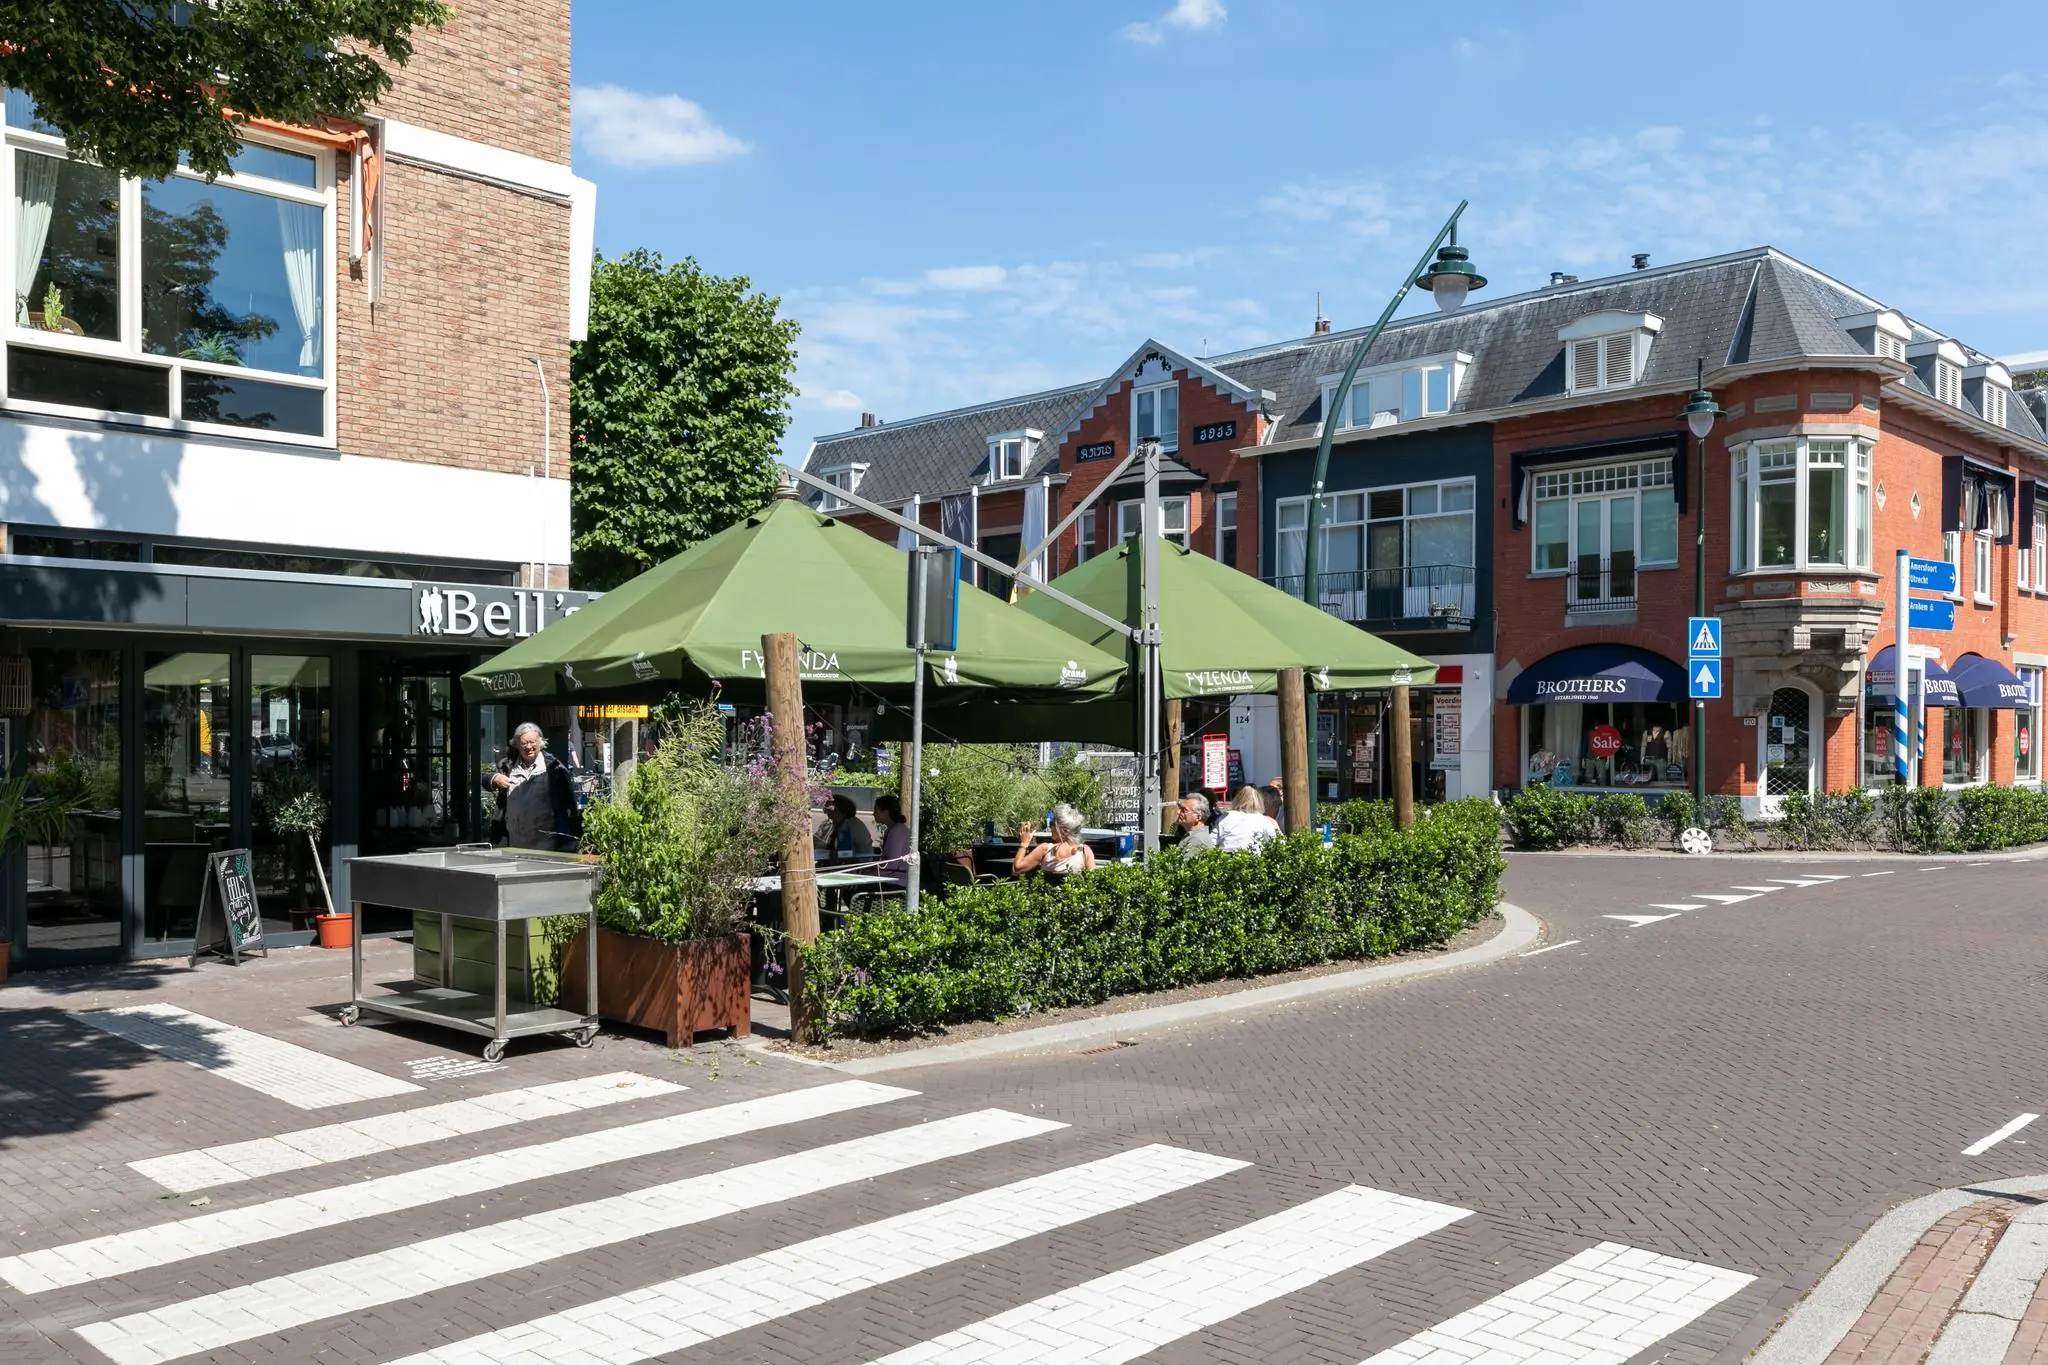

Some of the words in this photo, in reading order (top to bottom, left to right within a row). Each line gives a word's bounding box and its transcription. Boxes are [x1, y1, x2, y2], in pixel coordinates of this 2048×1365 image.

[1080, 446, 1112, 460] ANNO
[1910, 562, 1938, 573] Amersfoort
[1910, 575, 1929, 585] Utrecht
[1909, 601, 1928, 611] Arnhem
[742, 650, 840, 678] FANDA
[1536, 678, 1627, 695] BROTHERS
[1235, 715, 1250, 724] 124
[1592, 736, 1621, 749] Sale
